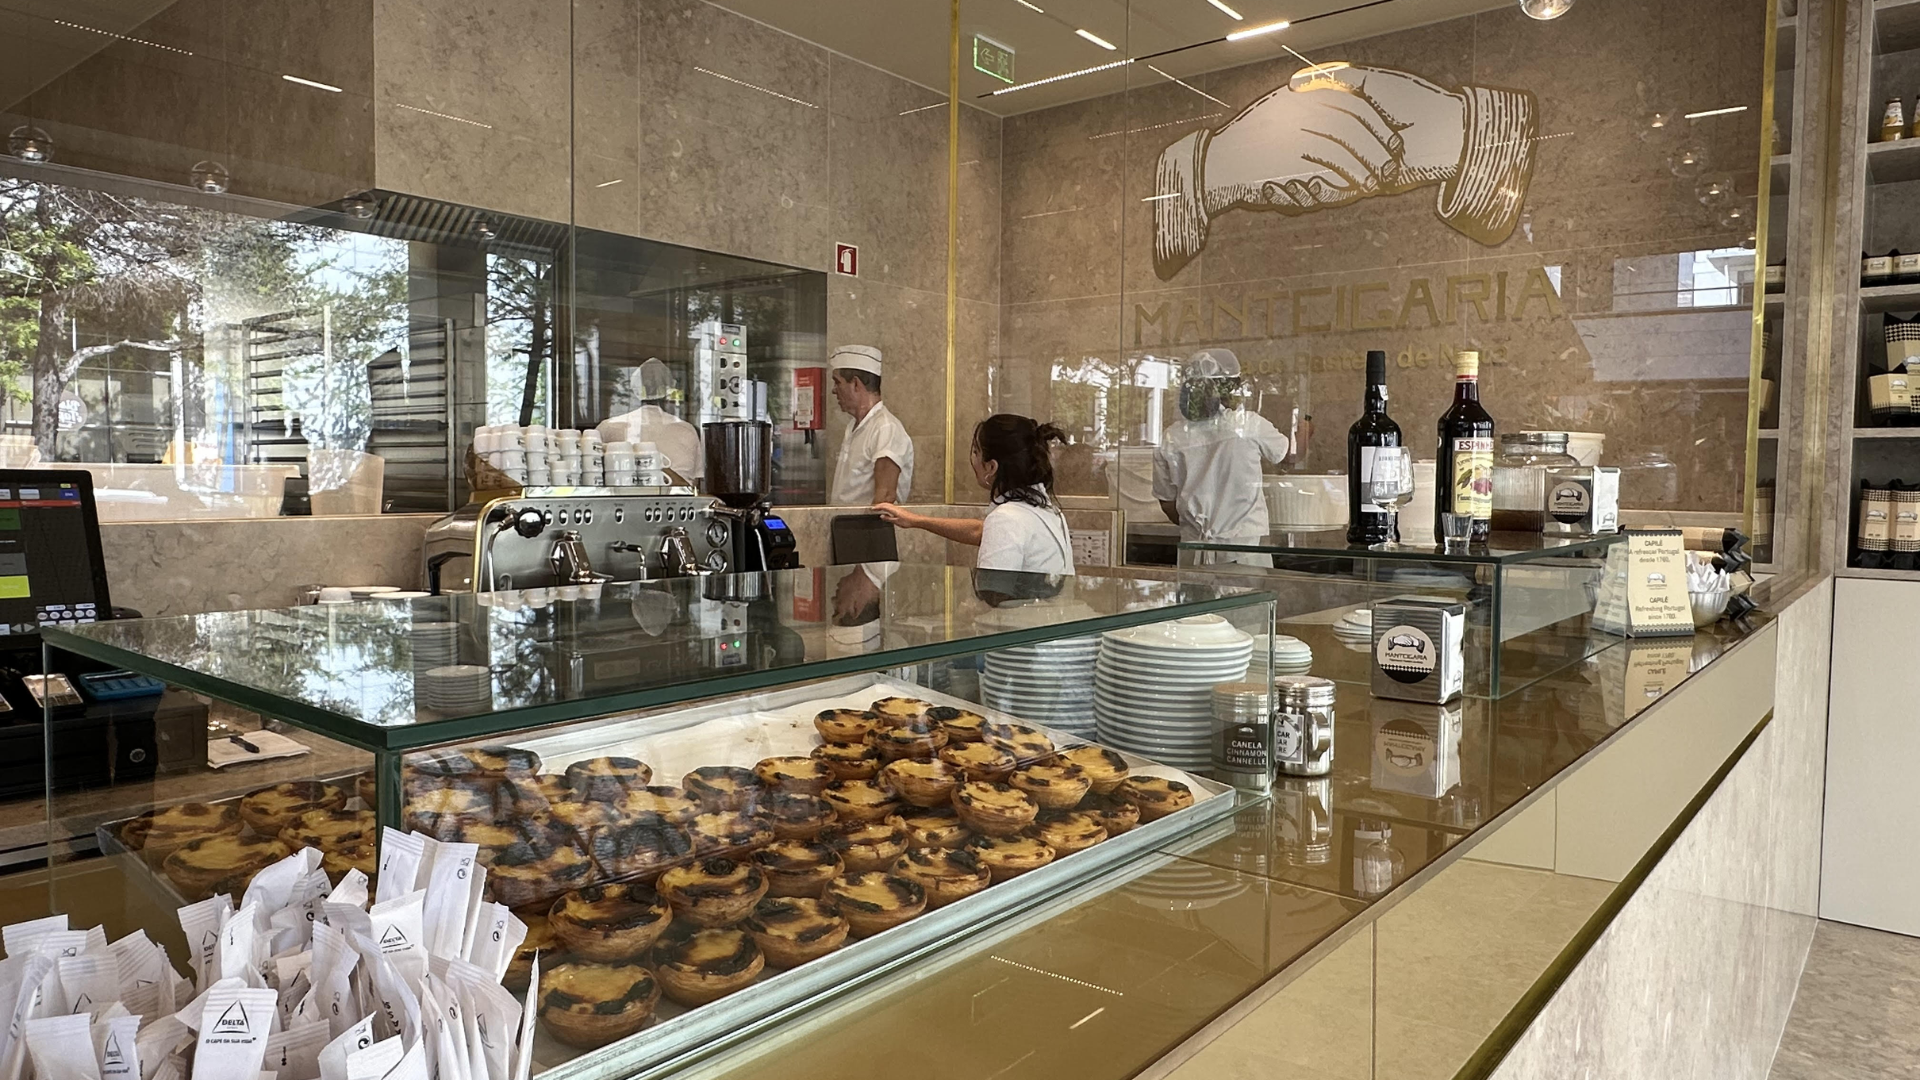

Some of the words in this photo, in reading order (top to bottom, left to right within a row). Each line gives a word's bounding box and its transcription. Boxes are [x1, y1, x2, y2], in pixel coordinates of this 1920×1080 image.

[1133, 266, 1562, 346] MANTEIGARIA
[1396, 344, 1433, 369] de
[1231, 740, 1262, 749] CANELA
[1226, 747, 1267, 757] CINNAMON
[1226, 755, 1267, 765] CANNELLE
